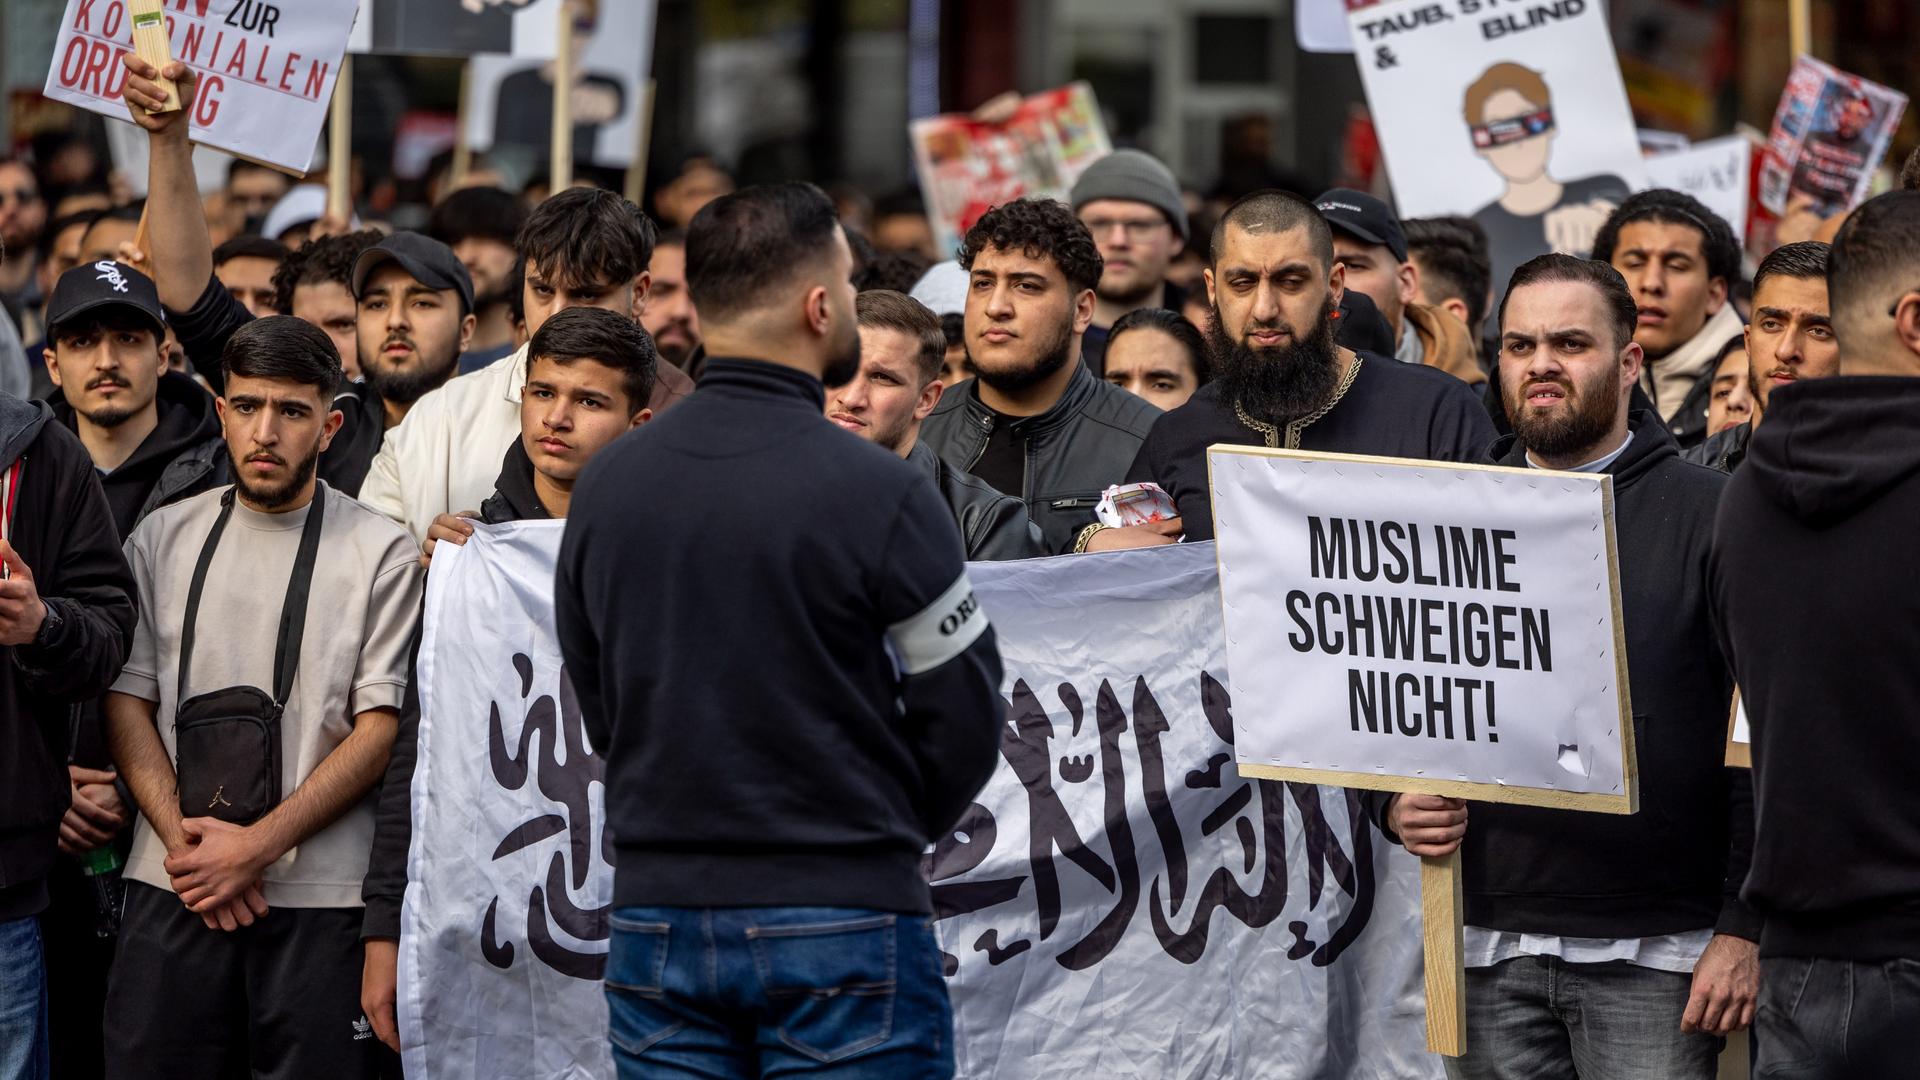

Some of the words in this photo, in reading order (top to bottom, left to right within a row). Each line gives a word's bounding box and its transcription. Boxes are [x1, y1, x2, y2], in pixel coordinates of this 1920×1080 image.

[73, 0, 329, 100] KONIALEN
[225, 0, 280, 38] ZUR
[1359, 4, 1453, 40] TAUB,
[1375, 46, 1399, 70] &
[1480, 0, 1586, 41] BLIND
[59, 35, 224, 127] ORDG
[1307, 515, 1521, 593] MUSLIME
[1285, 589, 1552, 672] SCHWEIGEN
[1348, 668, 1499, 743] NICHT!
